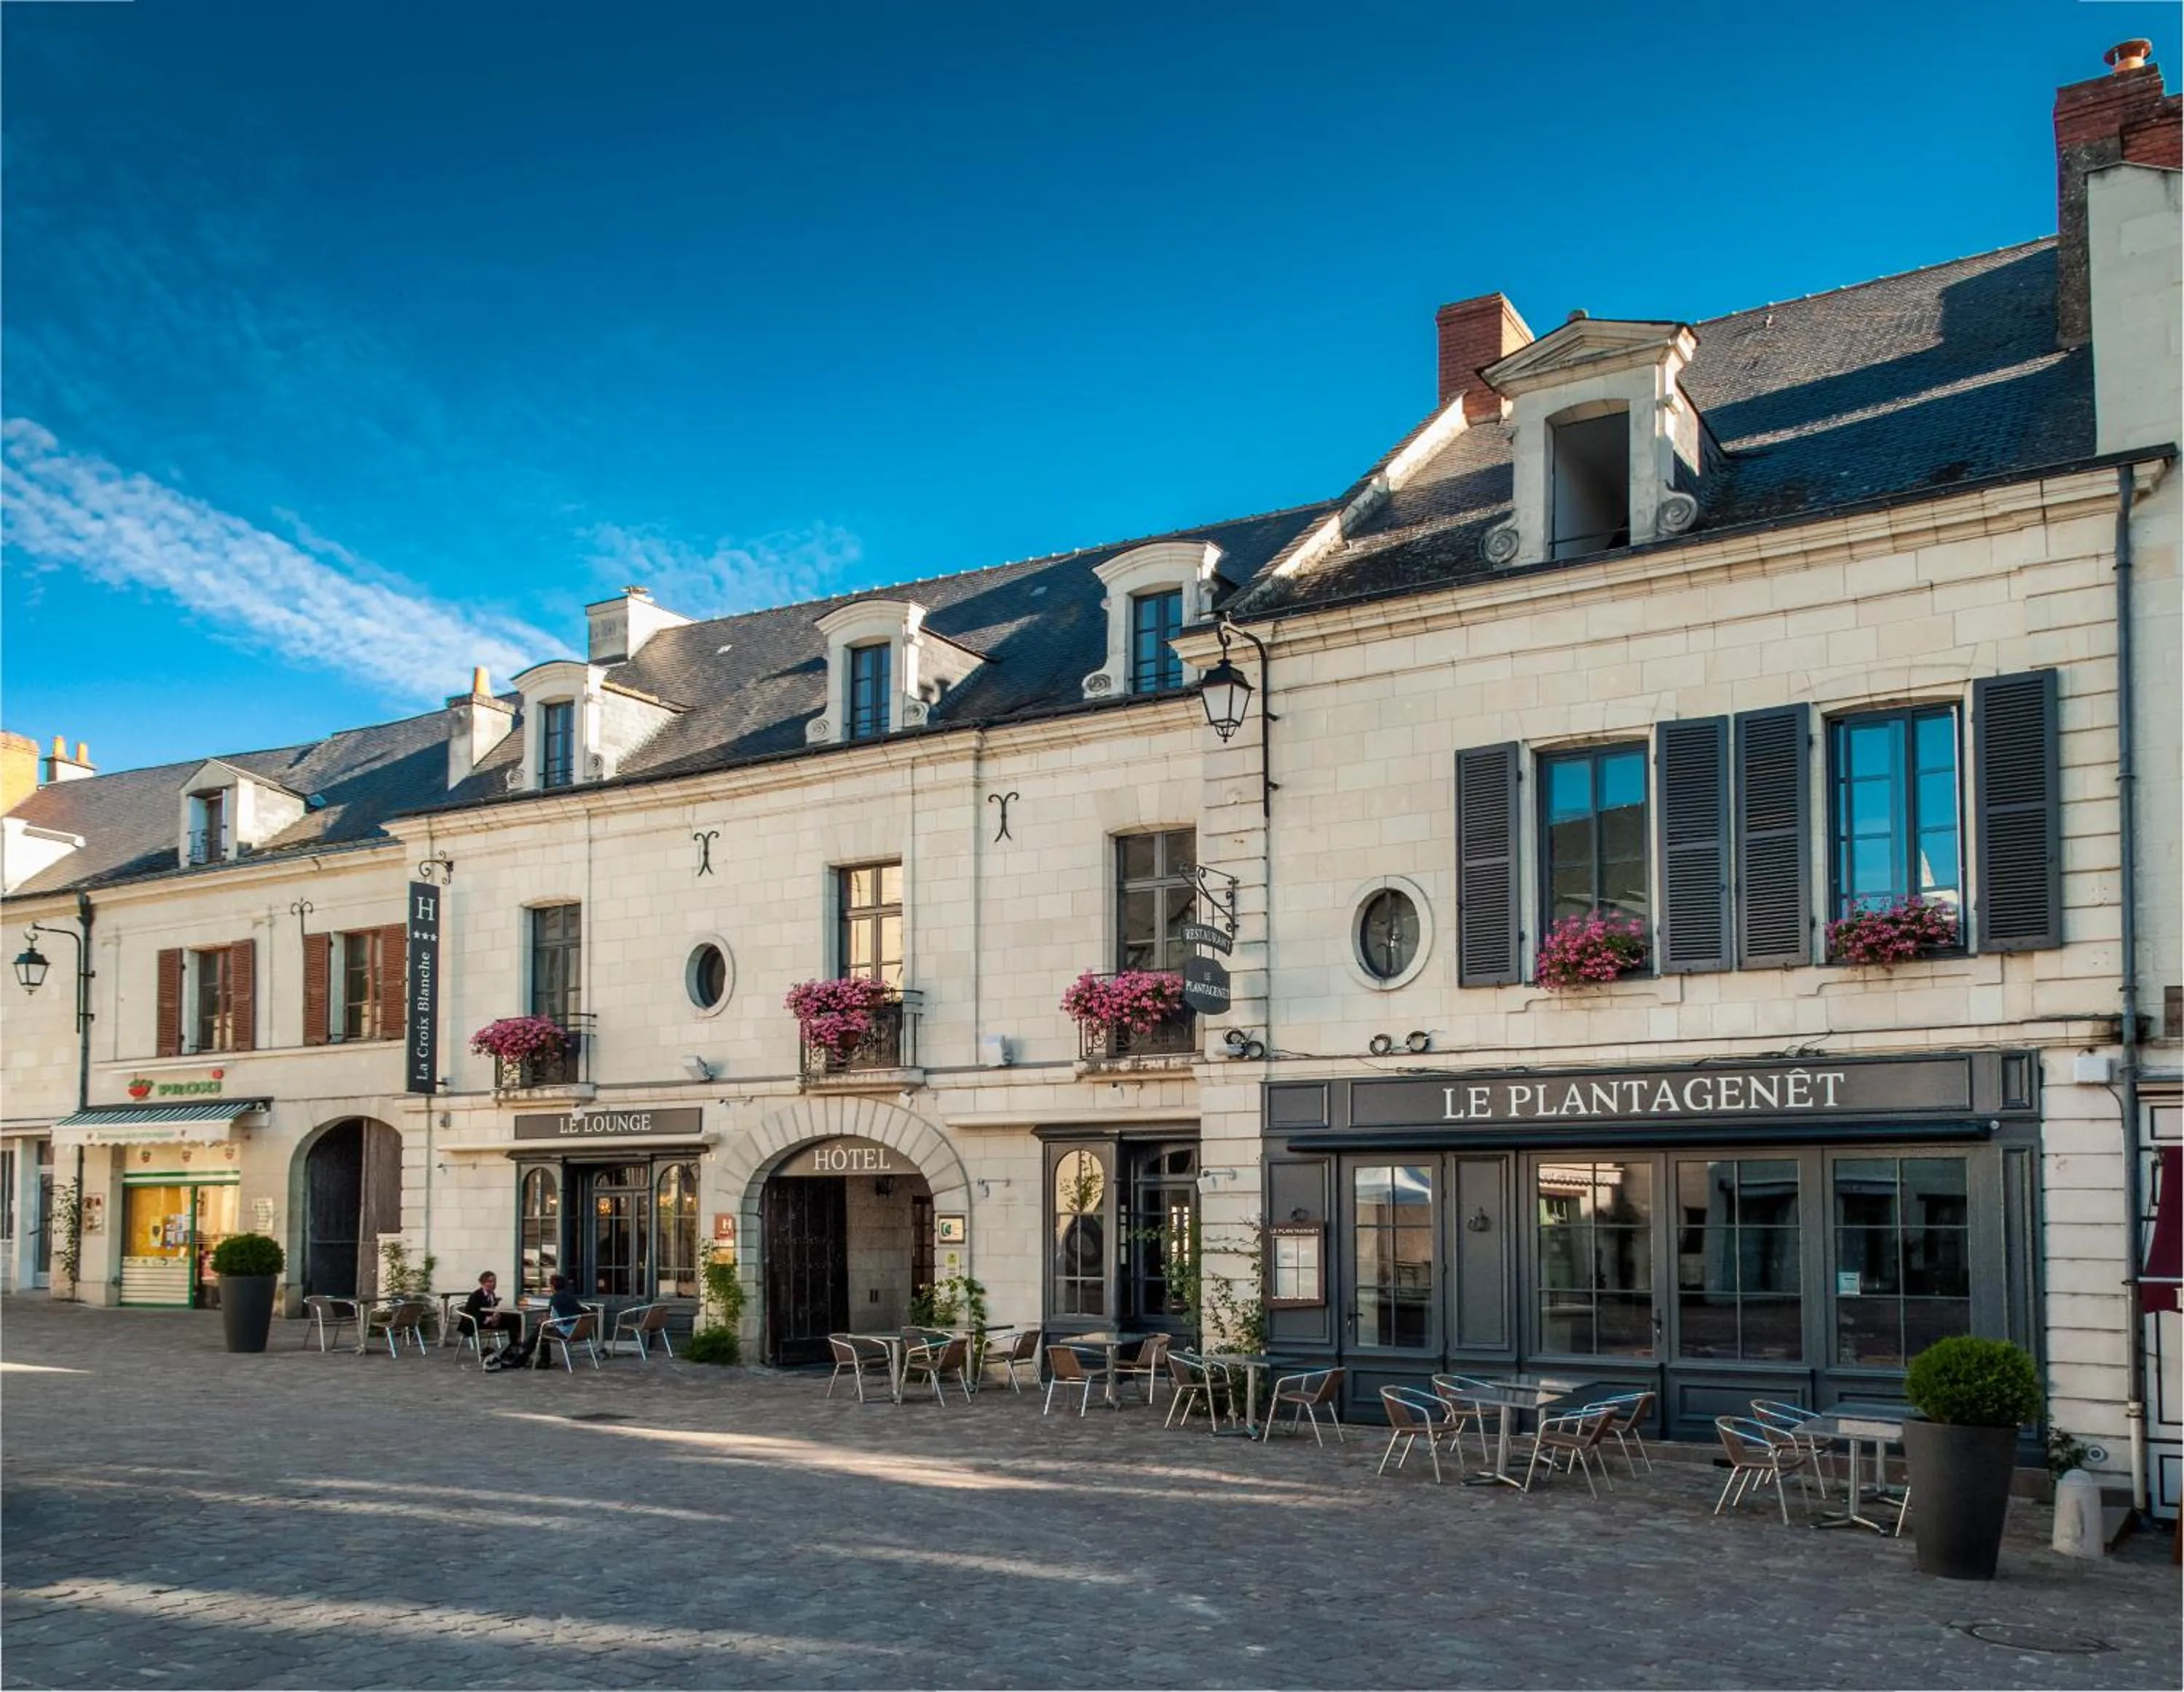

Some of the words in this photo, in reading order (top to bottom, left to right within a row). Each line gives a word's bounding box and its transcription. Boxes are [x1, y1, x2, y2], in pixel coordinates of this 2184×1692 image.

[416, 896, 436, 921] H
[1184, 928, 1230, 950] RESTAURANT
[418, 952, 430, 1012] Blanche
[416, 1017, 430, 1058] Croix
[416, 1064, 428, 1080] La
[1443, 1088, 1492, 1119] LE
[1508, 1068, 1844, 1118] PLANTAGENÊT
[559, 1118, 579, 1134] LE
[584, 1113, 652, 1132] LOUNGE
[814, 1144, 890, 1170] HÔTEL
